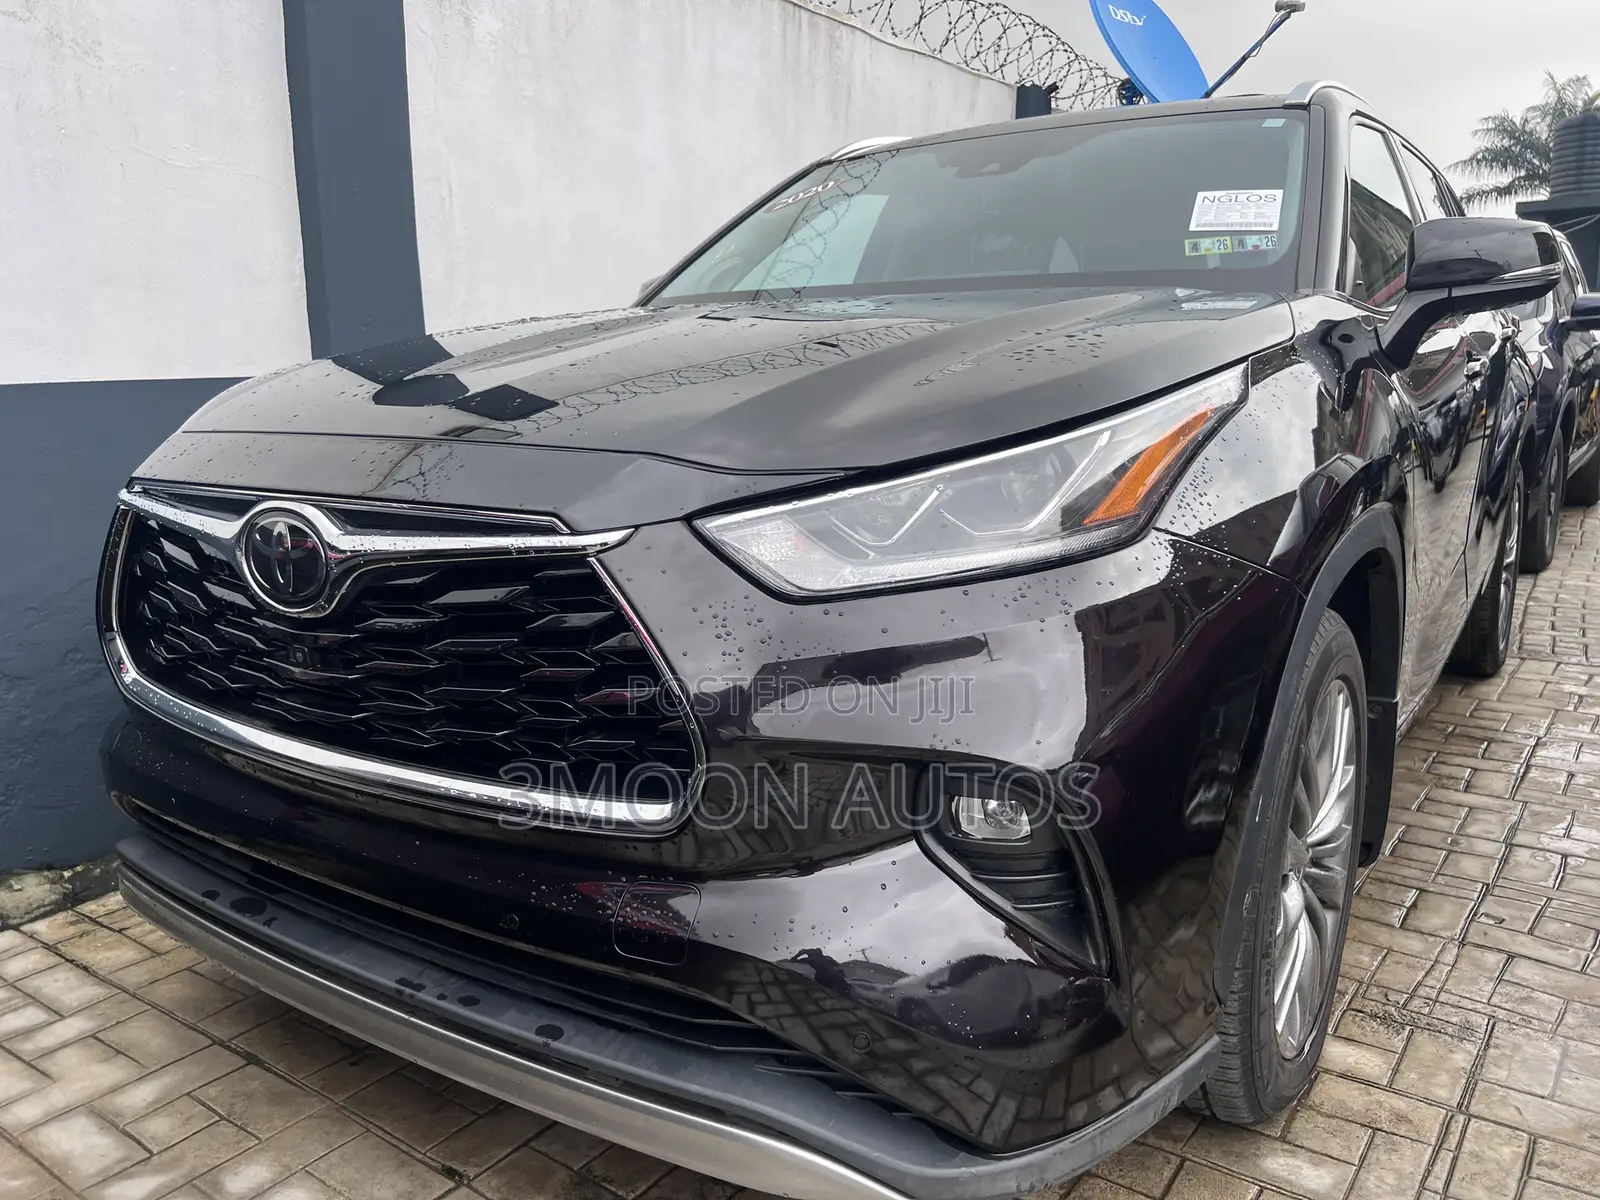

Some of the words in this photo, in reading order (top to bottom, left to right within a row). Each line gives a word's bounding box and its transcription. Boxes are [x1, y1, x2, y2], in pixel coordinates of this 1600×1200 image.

[772, 181, 835, 211] 2020
[1202, 194, 1277, 203] NGLOS
[1216, 239, 1229, 251] 26
[1264, 235, 1277, 247] 26
